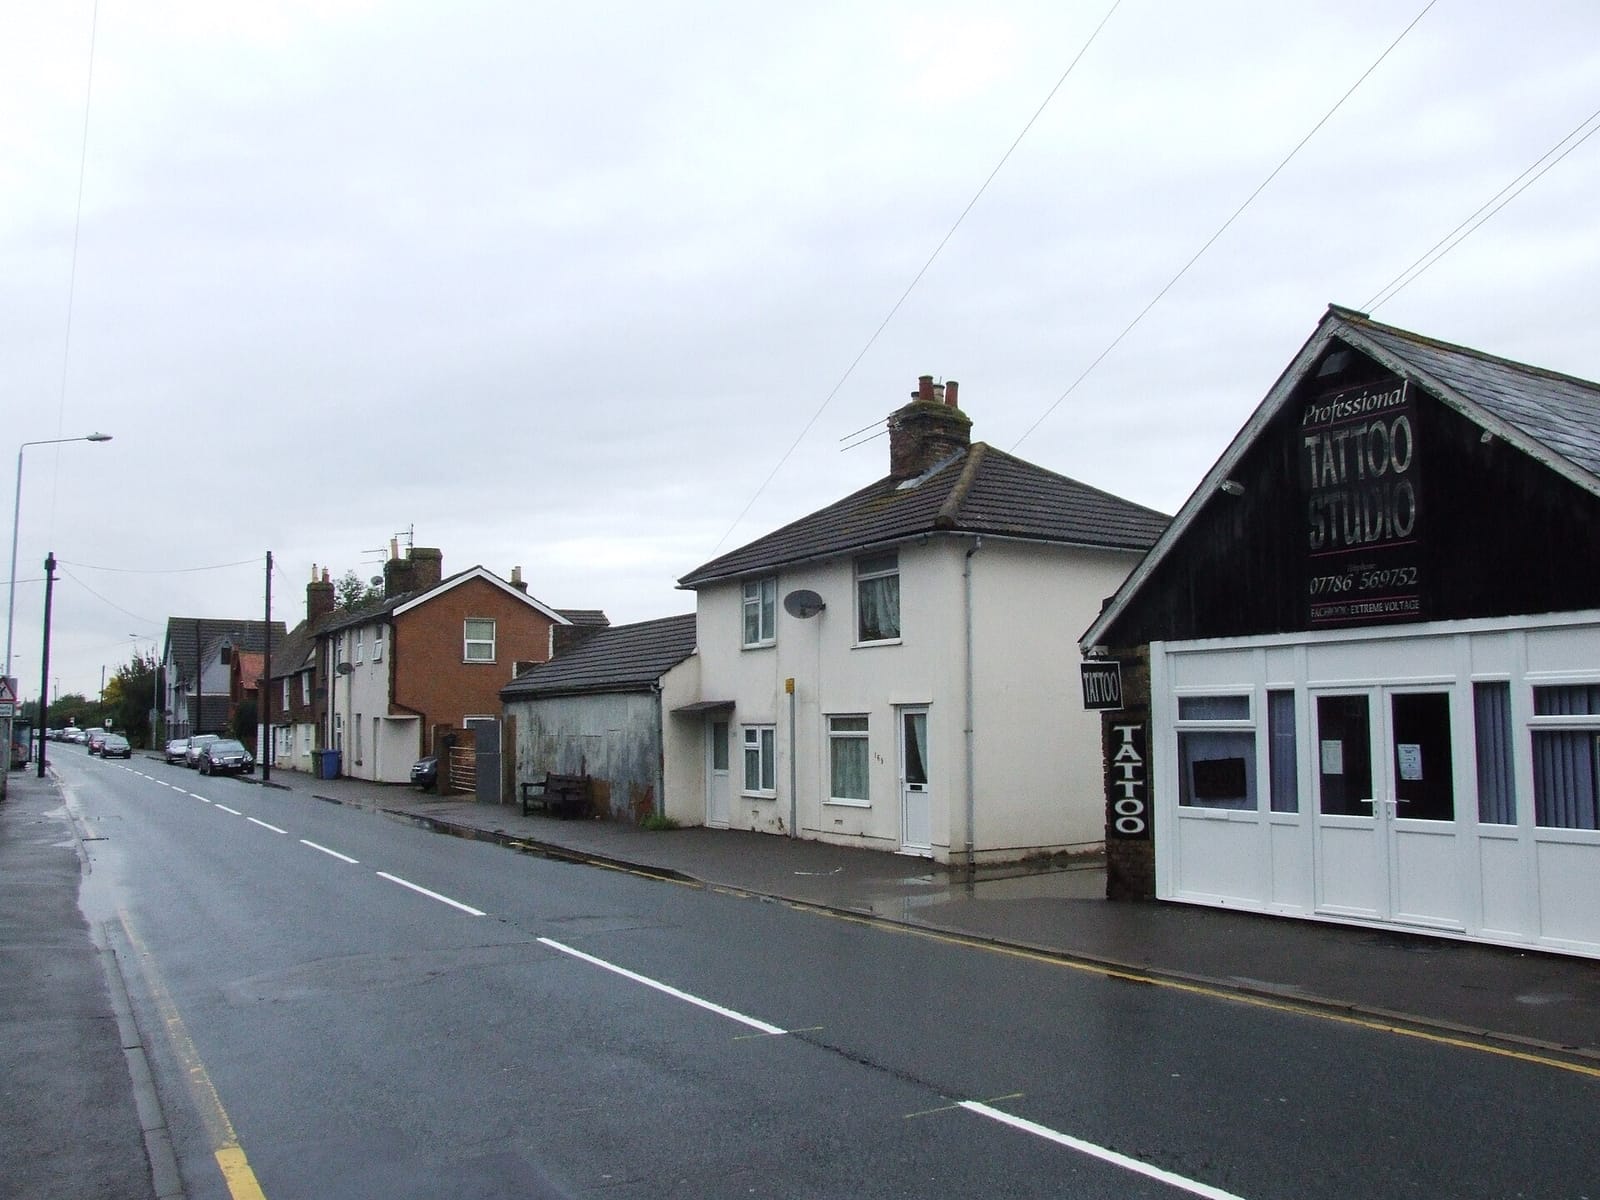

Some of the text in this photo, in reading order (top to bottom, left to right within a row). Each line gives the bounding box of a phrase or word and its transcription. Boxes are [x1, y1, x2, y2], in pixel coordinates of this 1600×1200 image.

[1303, 378, 1409, 425] Professional
[1304, 414, 1413, 487] TATTOO
[1308, 478, 1416, 549] STUDIO
[1309, 573, 1354, 594] 07786
[1358, 566, 1419, 590] 569752
[1351, 603, 1385, 614] EXTREME
[1385, 599, 1420, 612] VOLTAGE
[1083, 671, 1118, 703] TATTOO
[1113, 724, 1145, 834] TATTOO
